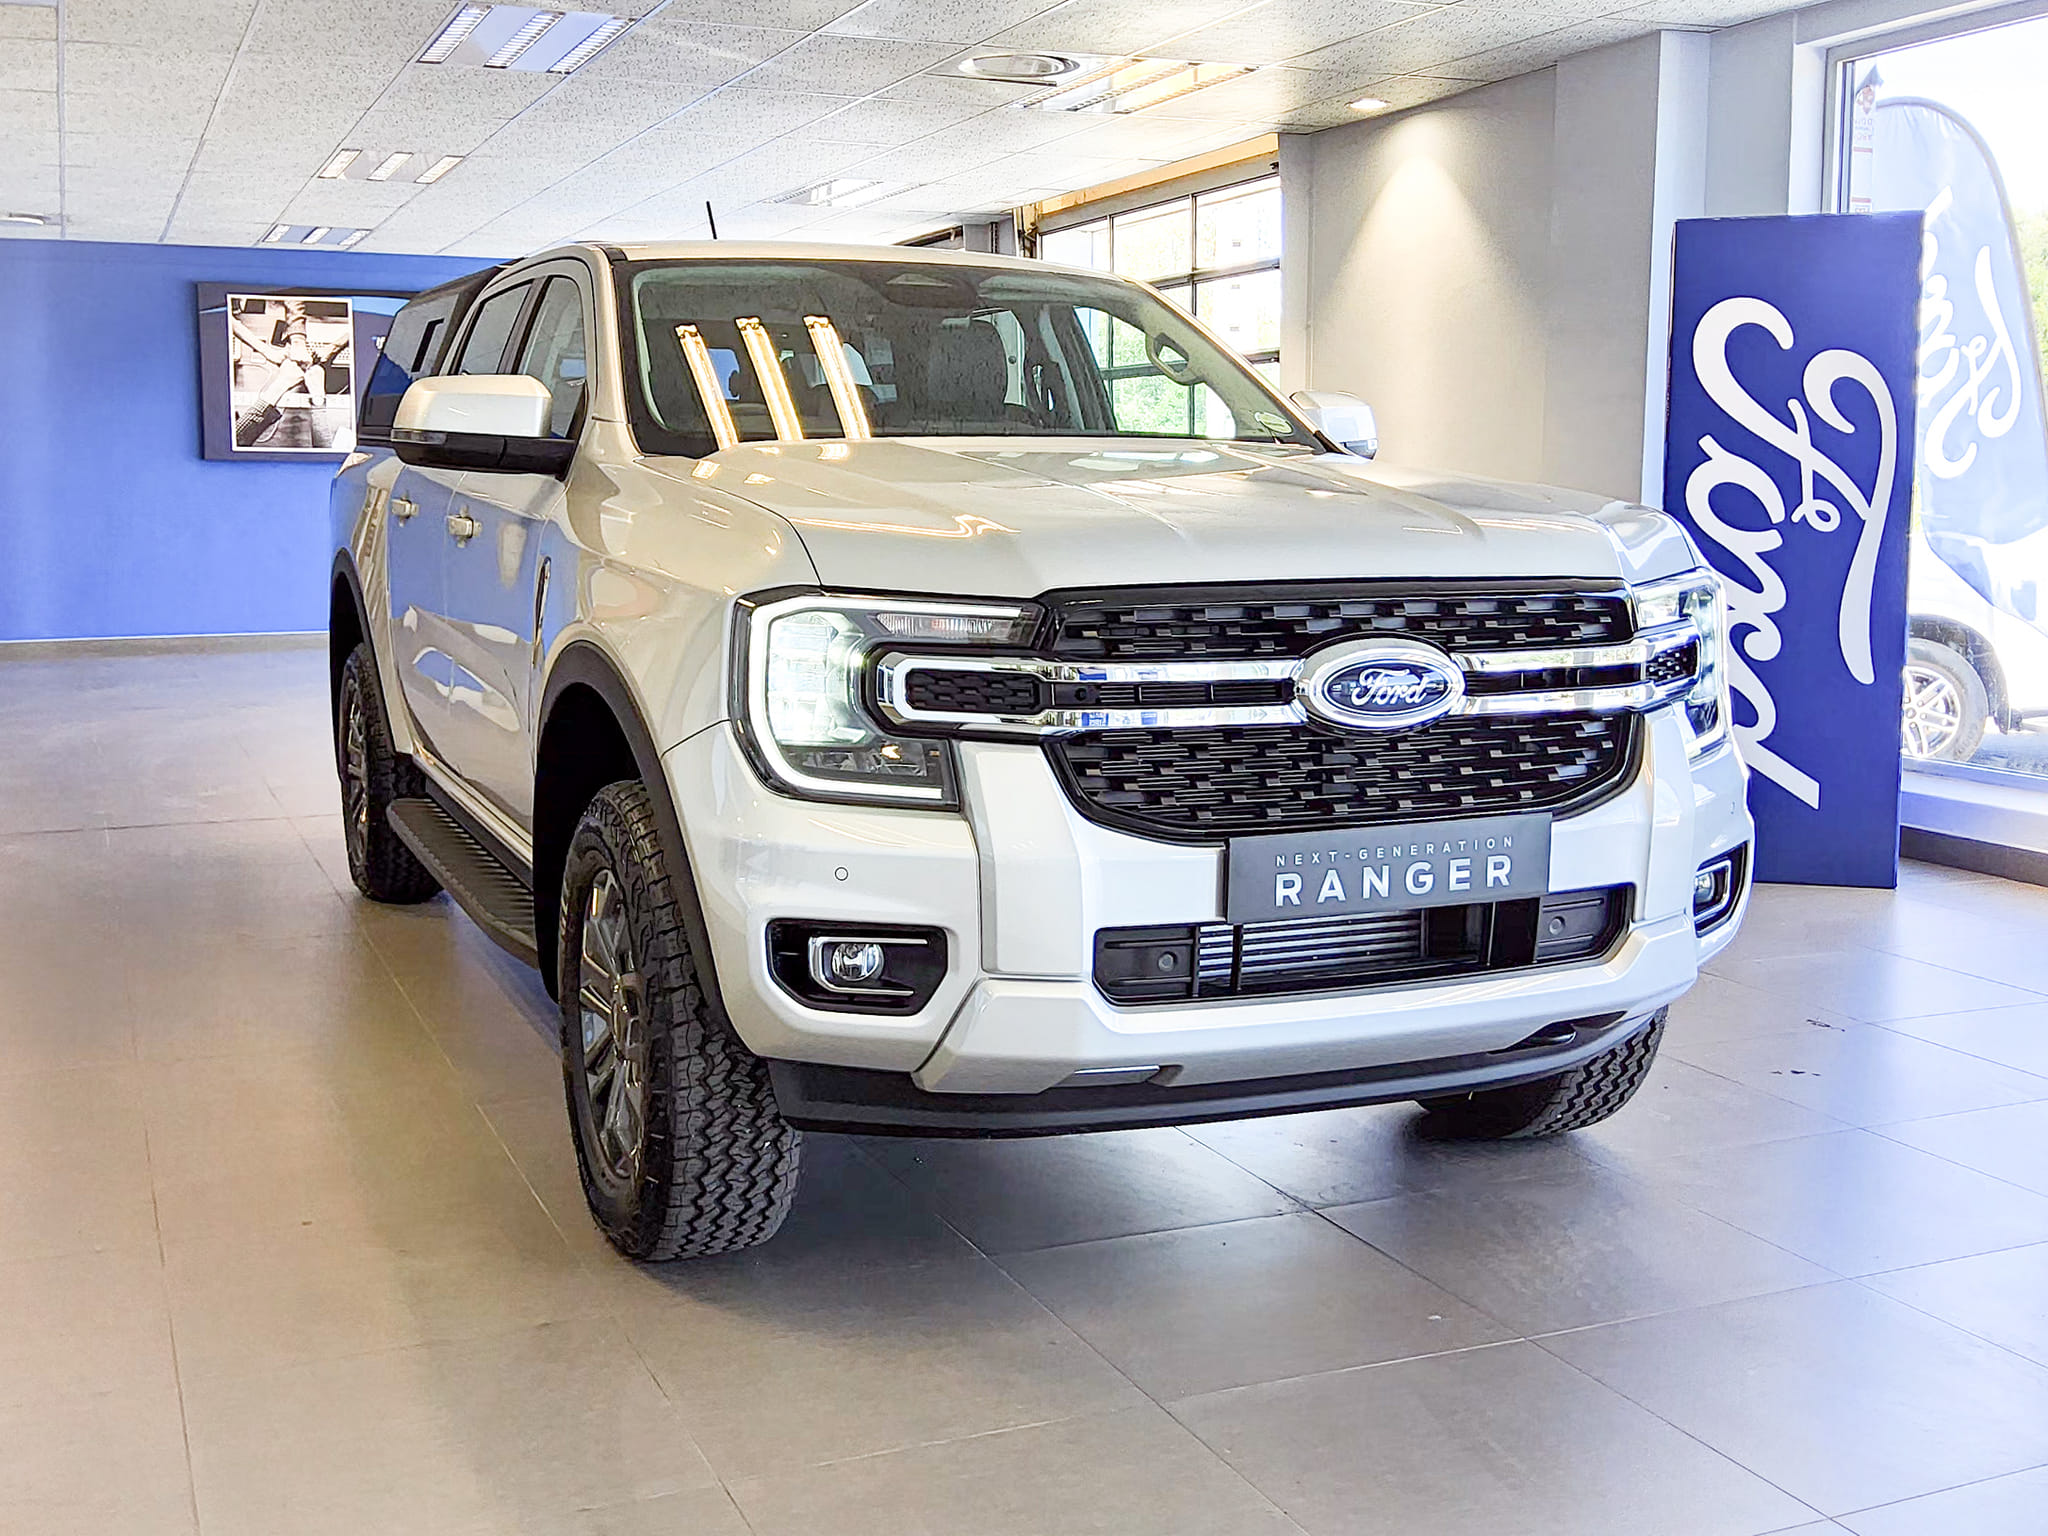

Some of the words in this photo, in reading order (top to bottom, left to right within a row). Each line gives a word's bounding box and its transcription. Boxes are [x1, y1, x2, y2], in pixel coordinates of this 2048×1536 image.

[1350, 667, 1431, 707] Ford
[1275, 835, 1514, 867] NEXT-GENERATION
[1274, 854, 1513, 908] RANGER
